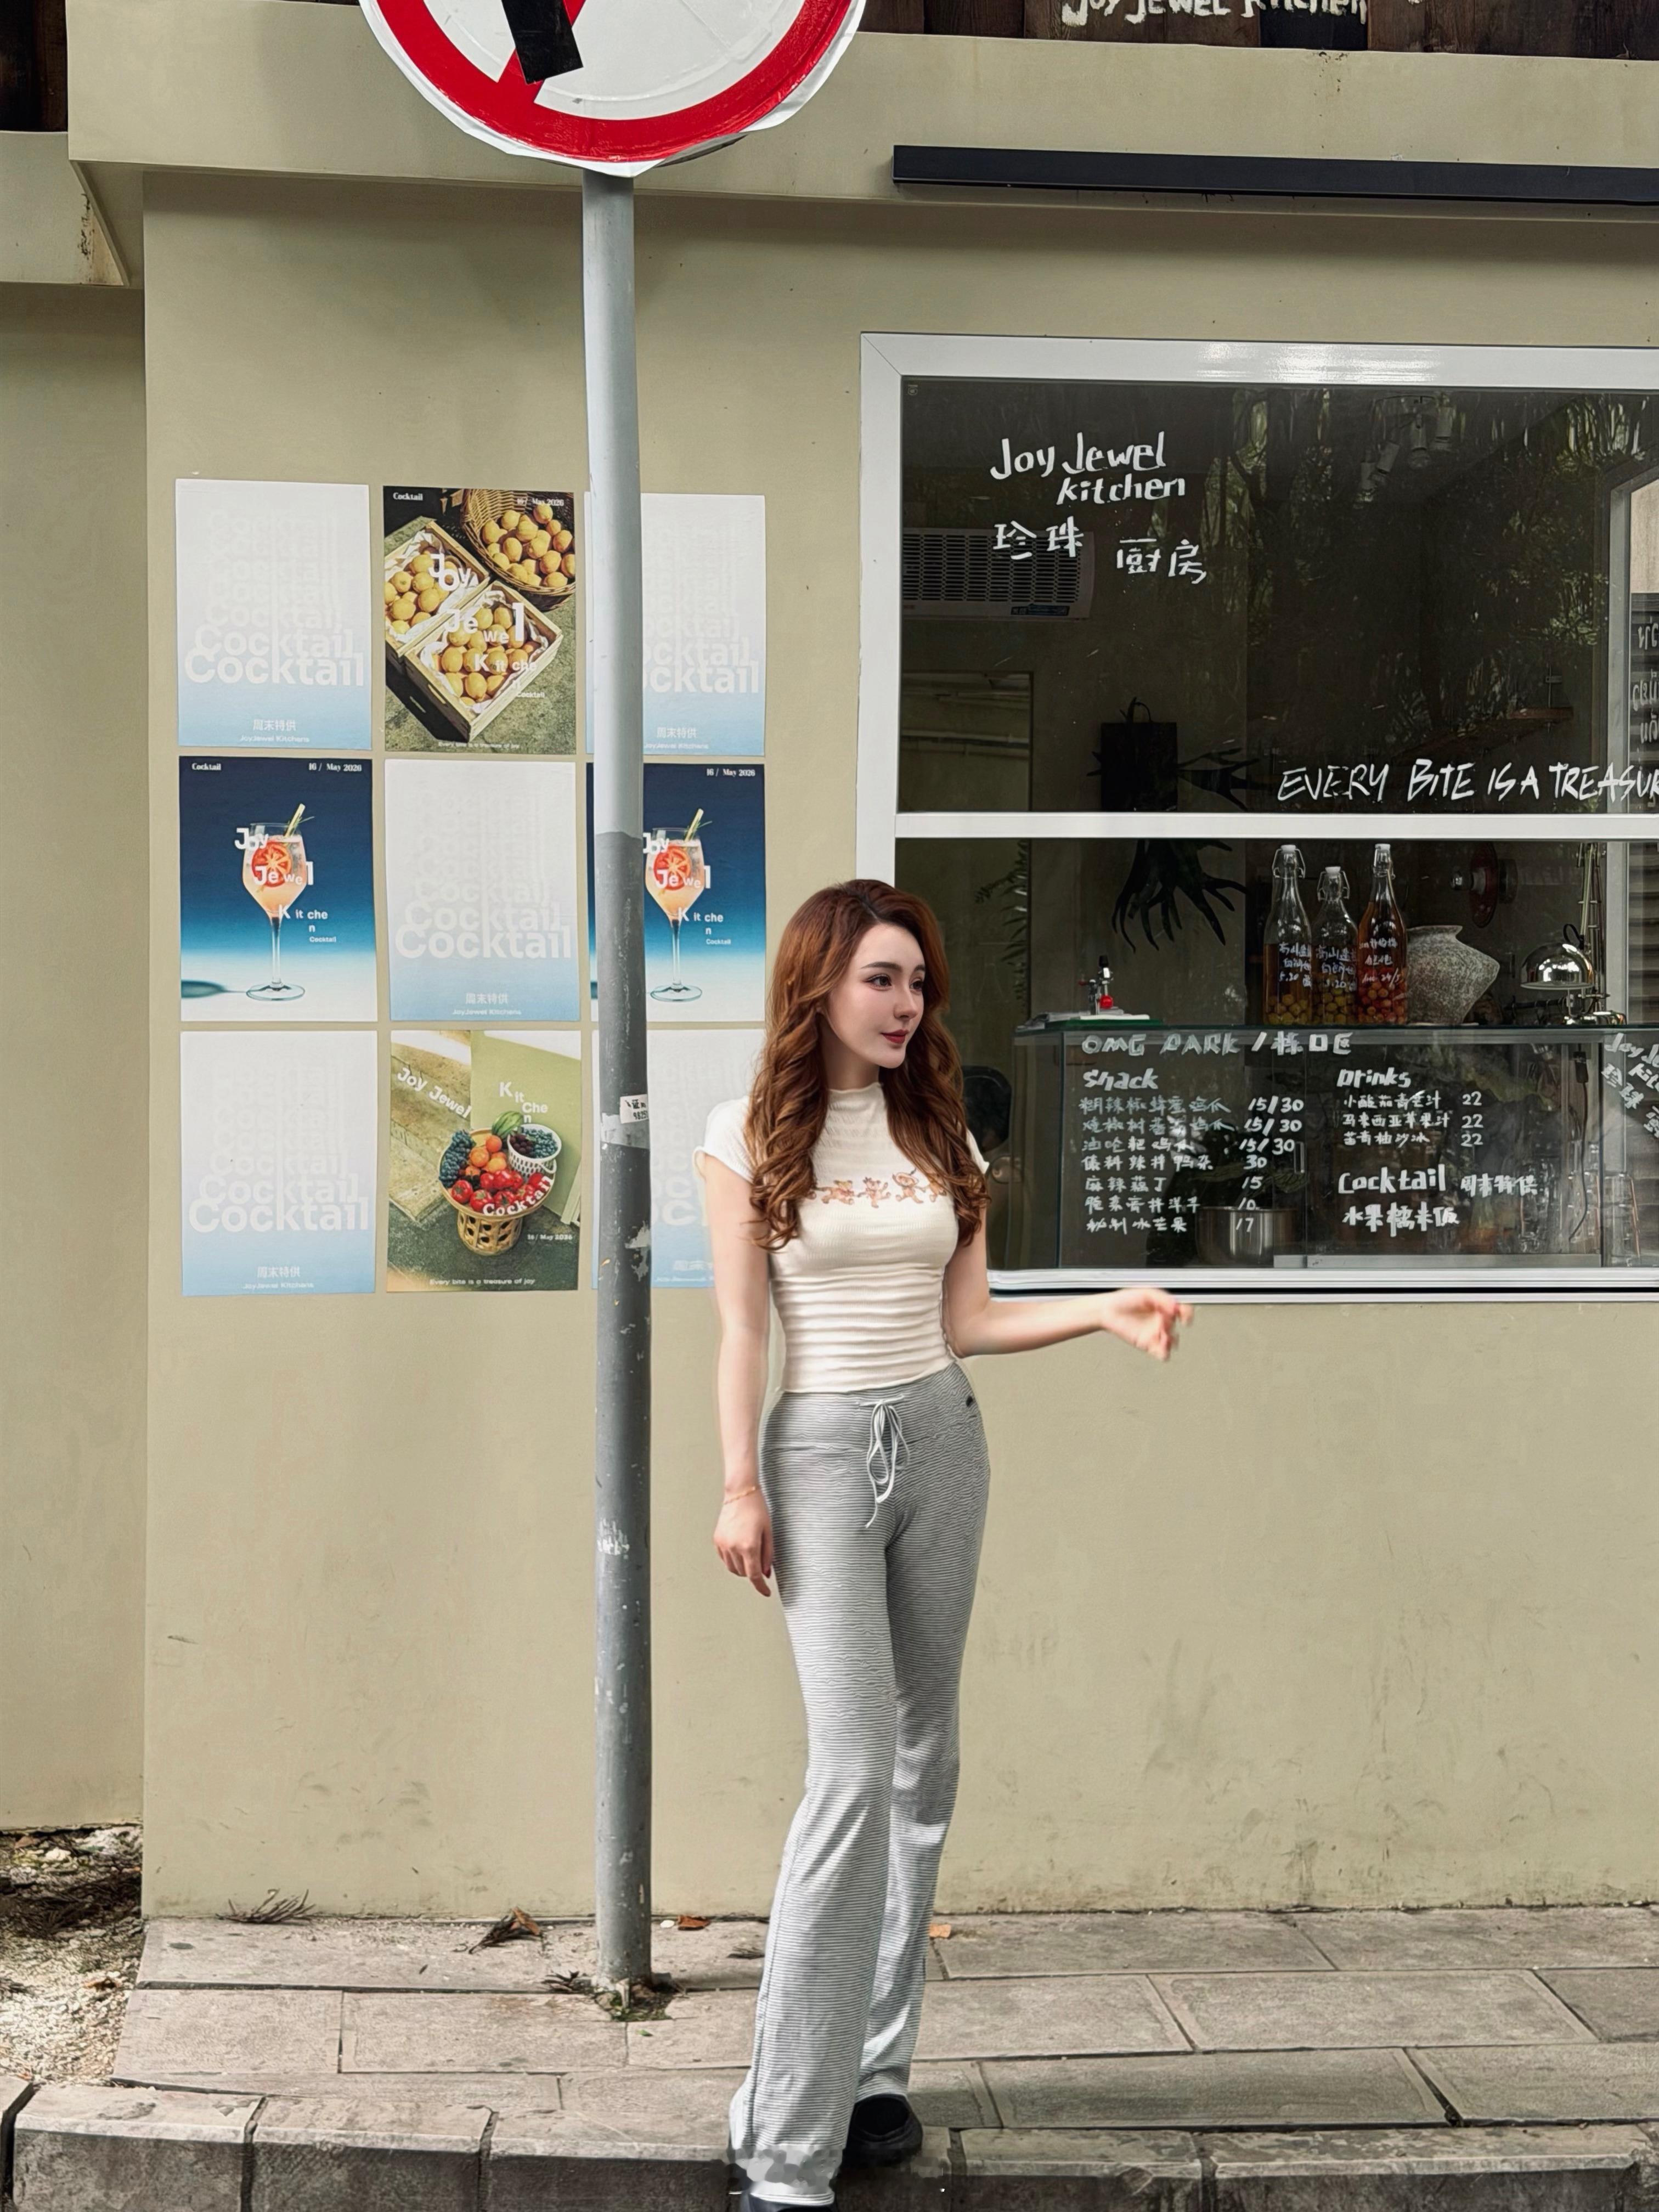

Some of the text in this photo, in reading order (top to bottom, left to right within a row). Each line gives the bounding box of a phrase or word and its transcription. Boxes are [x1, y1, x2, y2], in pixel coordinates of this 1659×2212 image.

[990, 430, 1167, 480] Joy Jewel
[185, 647, 364, 687] Cocktail
[643, 658, 759, 693] cktail
[192, 763, 222, 771] Cocktail
[326, 763, 341, 772] May
[343, 764, 362, 772] 2026
[723, 769, 737, 777] May
[1278, 764, 1390, 802] EVERY
[1520, 765, 1539, 800] A
[235, 827, 269, 850] Joy
[395, 924, 571, 959] Cocktail
[1081, 1034, 1146, 1056] OMG
[397, 1067, 472, 1119] Joy Jewel
[1462, 1091, 1482, 1107] 22
[1461, 1113, 1485, 1129] 22
[1460, 1133, 1484, 1148] 22
[1243, 1154, 1268, 1170] 30
[1242, 1177, 1263, 1190] 15
[1338, 1163, 1447, 1195] Cocktail
[482, 1175, 554, 1216] Cocktail
[188, 1197, 369, 1233] Cocktail
[1235, 1217, 1254, 1233] 17
